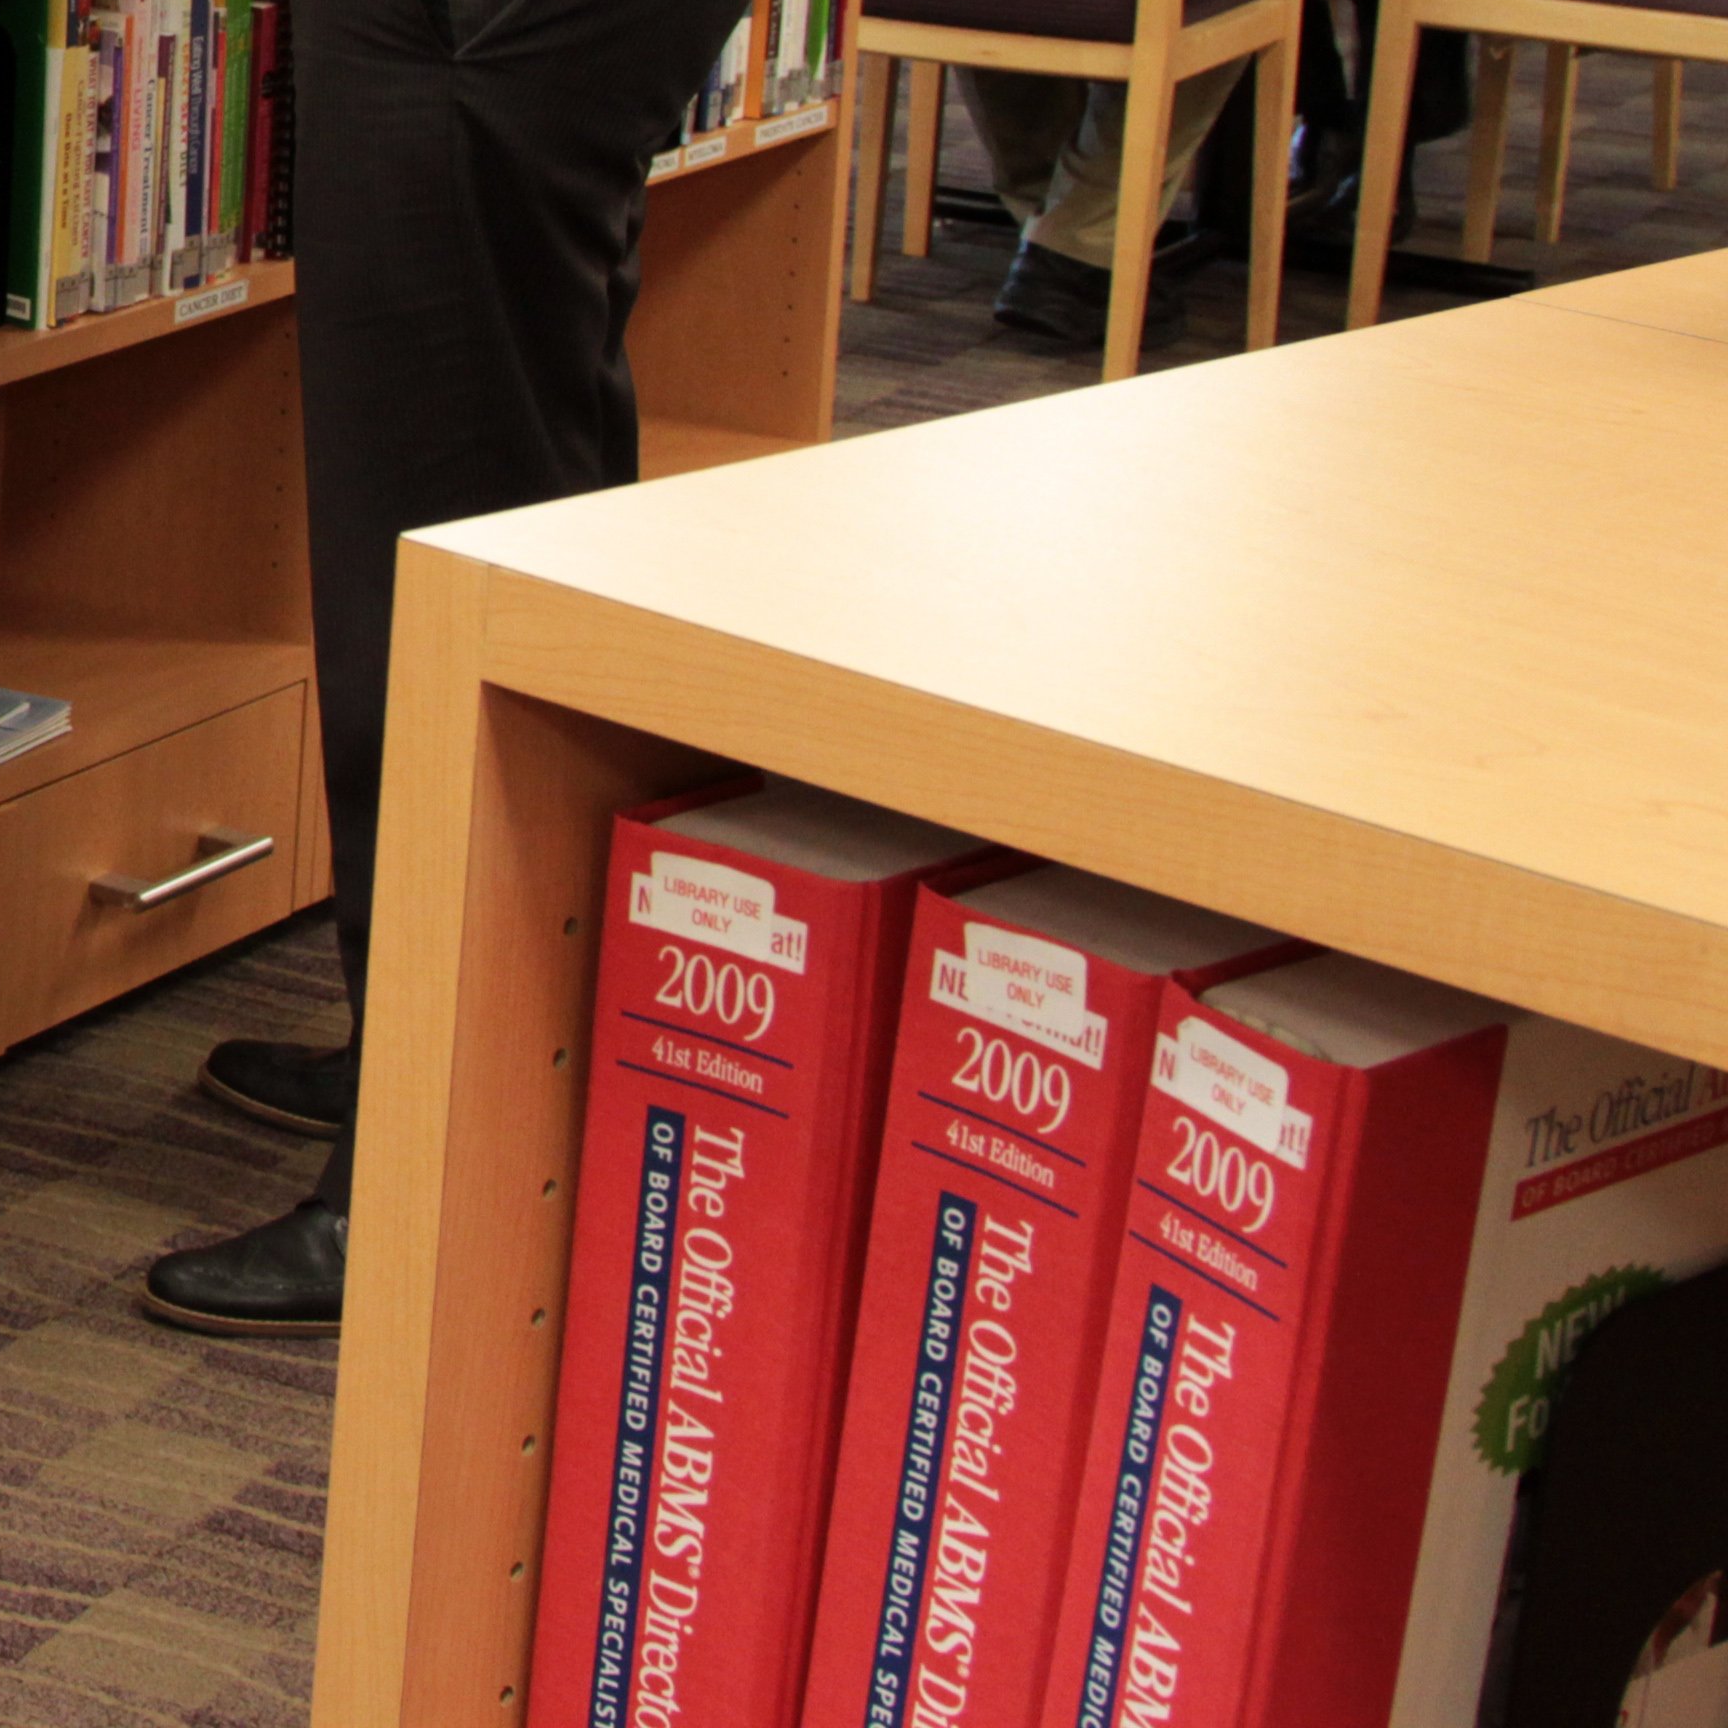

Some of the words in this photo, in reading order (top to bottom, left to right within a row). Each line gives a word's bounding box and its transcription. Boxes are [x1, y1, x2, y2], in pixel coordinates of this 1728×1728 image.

[178, 292, 220, 317] CANCER
[222, 285, 244, 304] DIET
[664, 874, 731, 909] LIBRARY
[732, 892, 762, 919] USE
[691, 906, 732, 935] ONLY
[653, 944, 775, 1041] 2009
[977, 947, 1043, 985] LIBRARY
[1044, 971, 1074, 998] USE
[1006, 979, 1047, 1010] ONLY
[651, 1034, 690, 1065] 41st
[695, 1046, 764, 1095] Edition
[951, 1028, 1072, 1133] 2009
[945, 1118, 986, 1155] 41st
[989, 1135, 1056, 1188] Edition
[1524, 1108, 1577, 1167] The
[1589, 1065, 1695, 1137] Official
[687, 1124, 745, 1218] The
[1167, 1117, 1275, 1234] 2009
[943, 1206, 968, 1248] OF
[974, 1216, 1035, 1312] The
[1158, 1211, 1195, 1254] 41st
[1197, 1233, 1259, 1293] Edition
[669, 1233, 734, 1405] Official
[928, 1258, 960, 1363] BOARD
[901, 1372, 944, 1523] CERTIFIED
[948, 1319, 1017, 1497] Official
[880, 1534, 921, 1658] MEDICAL
[635, 1571, 699, 1728] Directo
